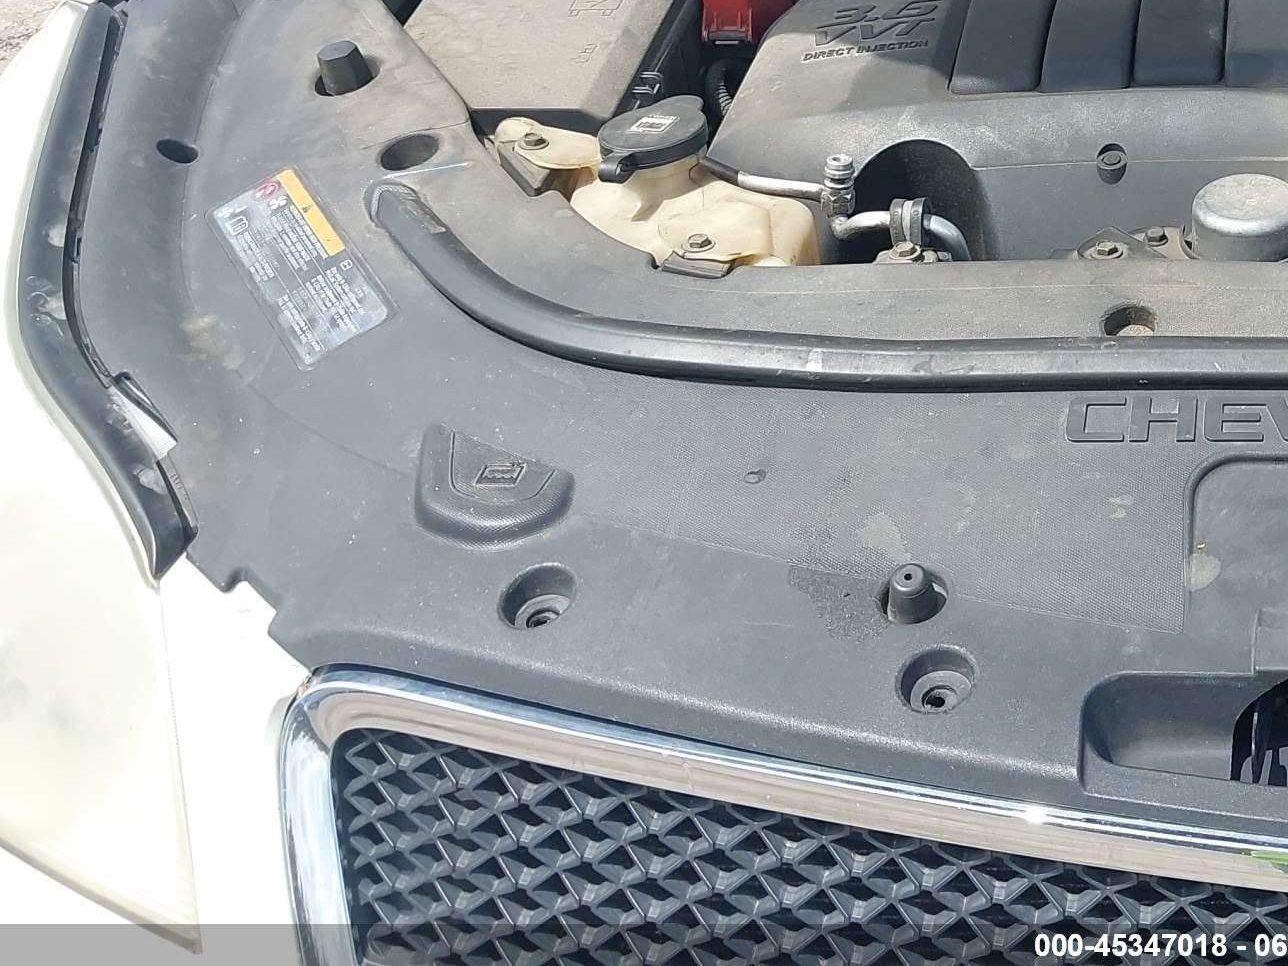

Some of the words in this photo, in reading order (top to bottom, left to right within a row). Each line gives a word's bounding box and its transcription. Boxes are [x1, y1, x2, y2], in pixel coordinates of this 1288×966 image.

[814, 17, 936, 47] VVT
[802, 46, 855, 62] DIRECT
[856, 39, 929, 55] INJECTION
